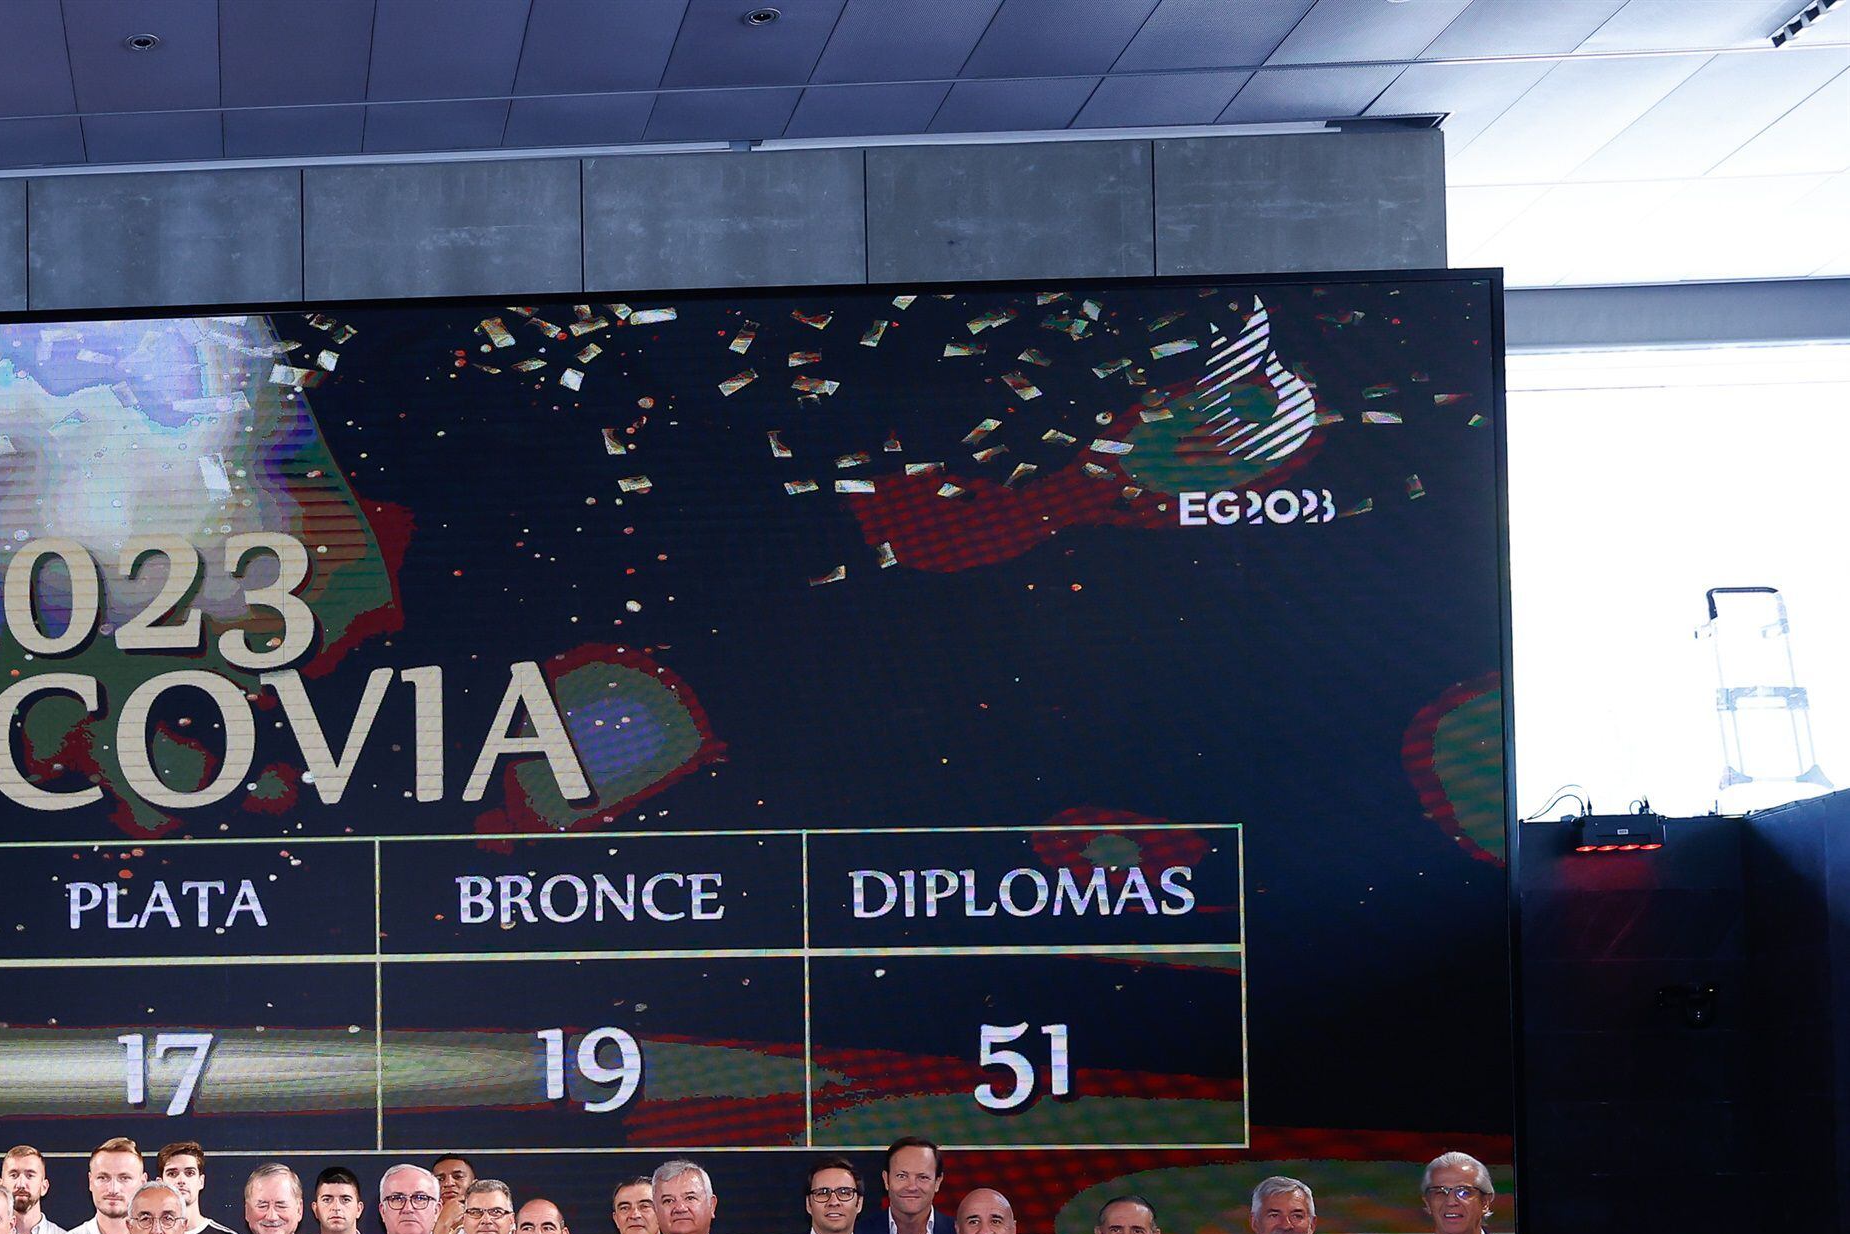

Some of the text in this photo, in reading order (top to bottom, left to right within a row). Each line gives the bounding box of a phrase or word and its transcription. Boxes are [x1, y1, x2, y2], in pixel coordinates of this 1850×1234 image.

[65, 879, 268, 931] PLATA
[456, 871, 727, 926] BRONCE
[850, 865, 1196, 921] DIPLOMAS
[117, 1032, 215, 1118] 17
[538, 1027, 642, 1114] 19
[975, 1022, 1072, 1112] 51
